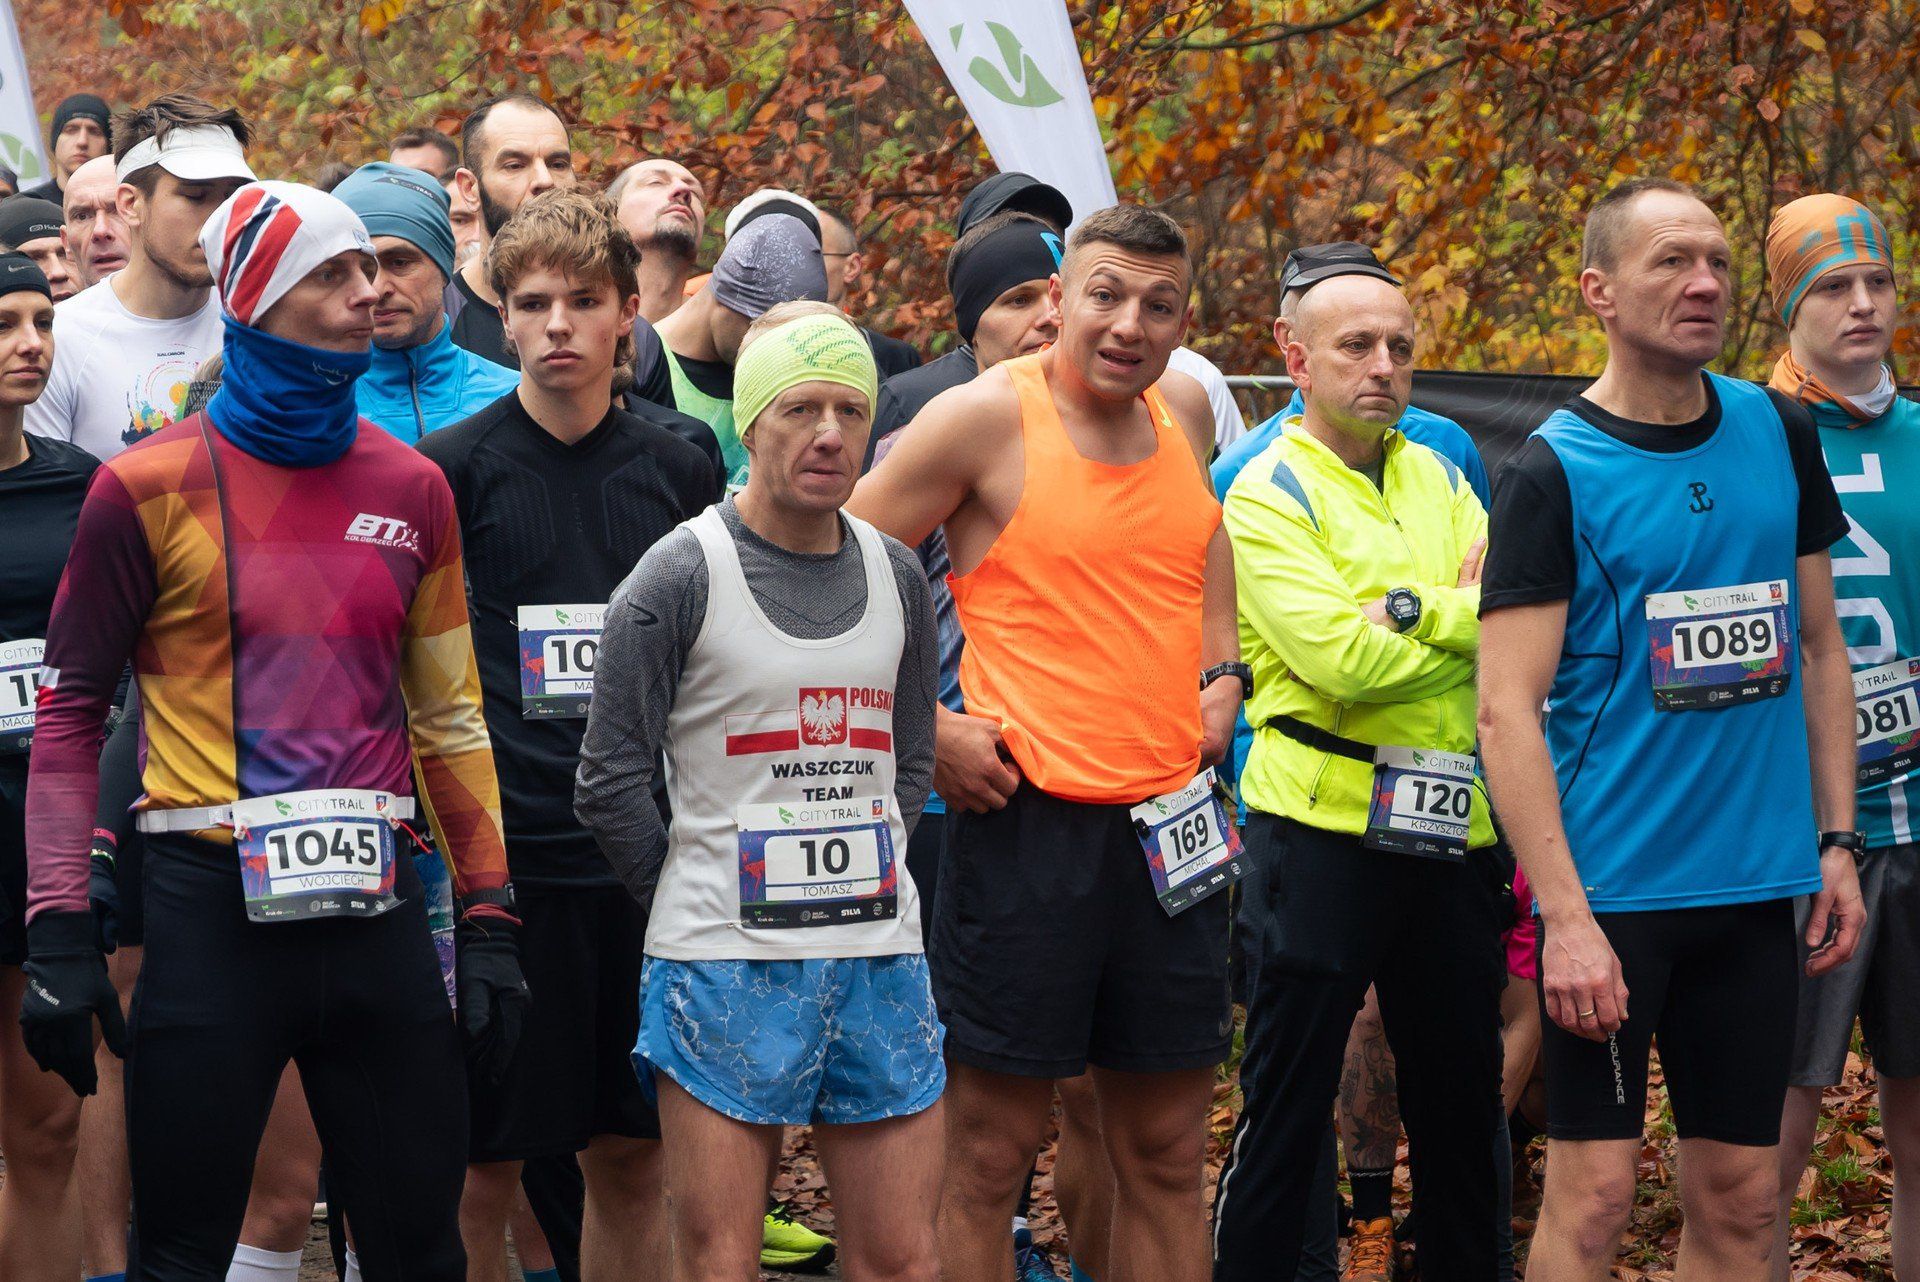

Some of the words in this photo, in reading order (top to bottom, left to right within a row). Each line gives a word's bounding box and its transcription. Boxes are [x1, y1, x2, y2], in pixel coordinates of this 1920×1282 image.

[574, 612, 602, 624] CITY
[1675, 619, 1771, 662] 1089
[551, 639, 598, 673] 10
[574, 681, 594, 691] MA
[771, 760, 875, 779] WASZCZUK
[802, 786, 854, 802] TEAM
[1413, 780, 1471, 819] 120
[1169, 812, 1209, 861] 169
[1411, 819, 1468, 837] KRZYSZTOF
[269, 827, 378, 870] 1045
[800, 838, 850, 876] 10
[300, 873, 364, 888] WOJCIECH
[801, 883, 853, 897] TOMASZ
[841, 908, 861, 917] SILVA
